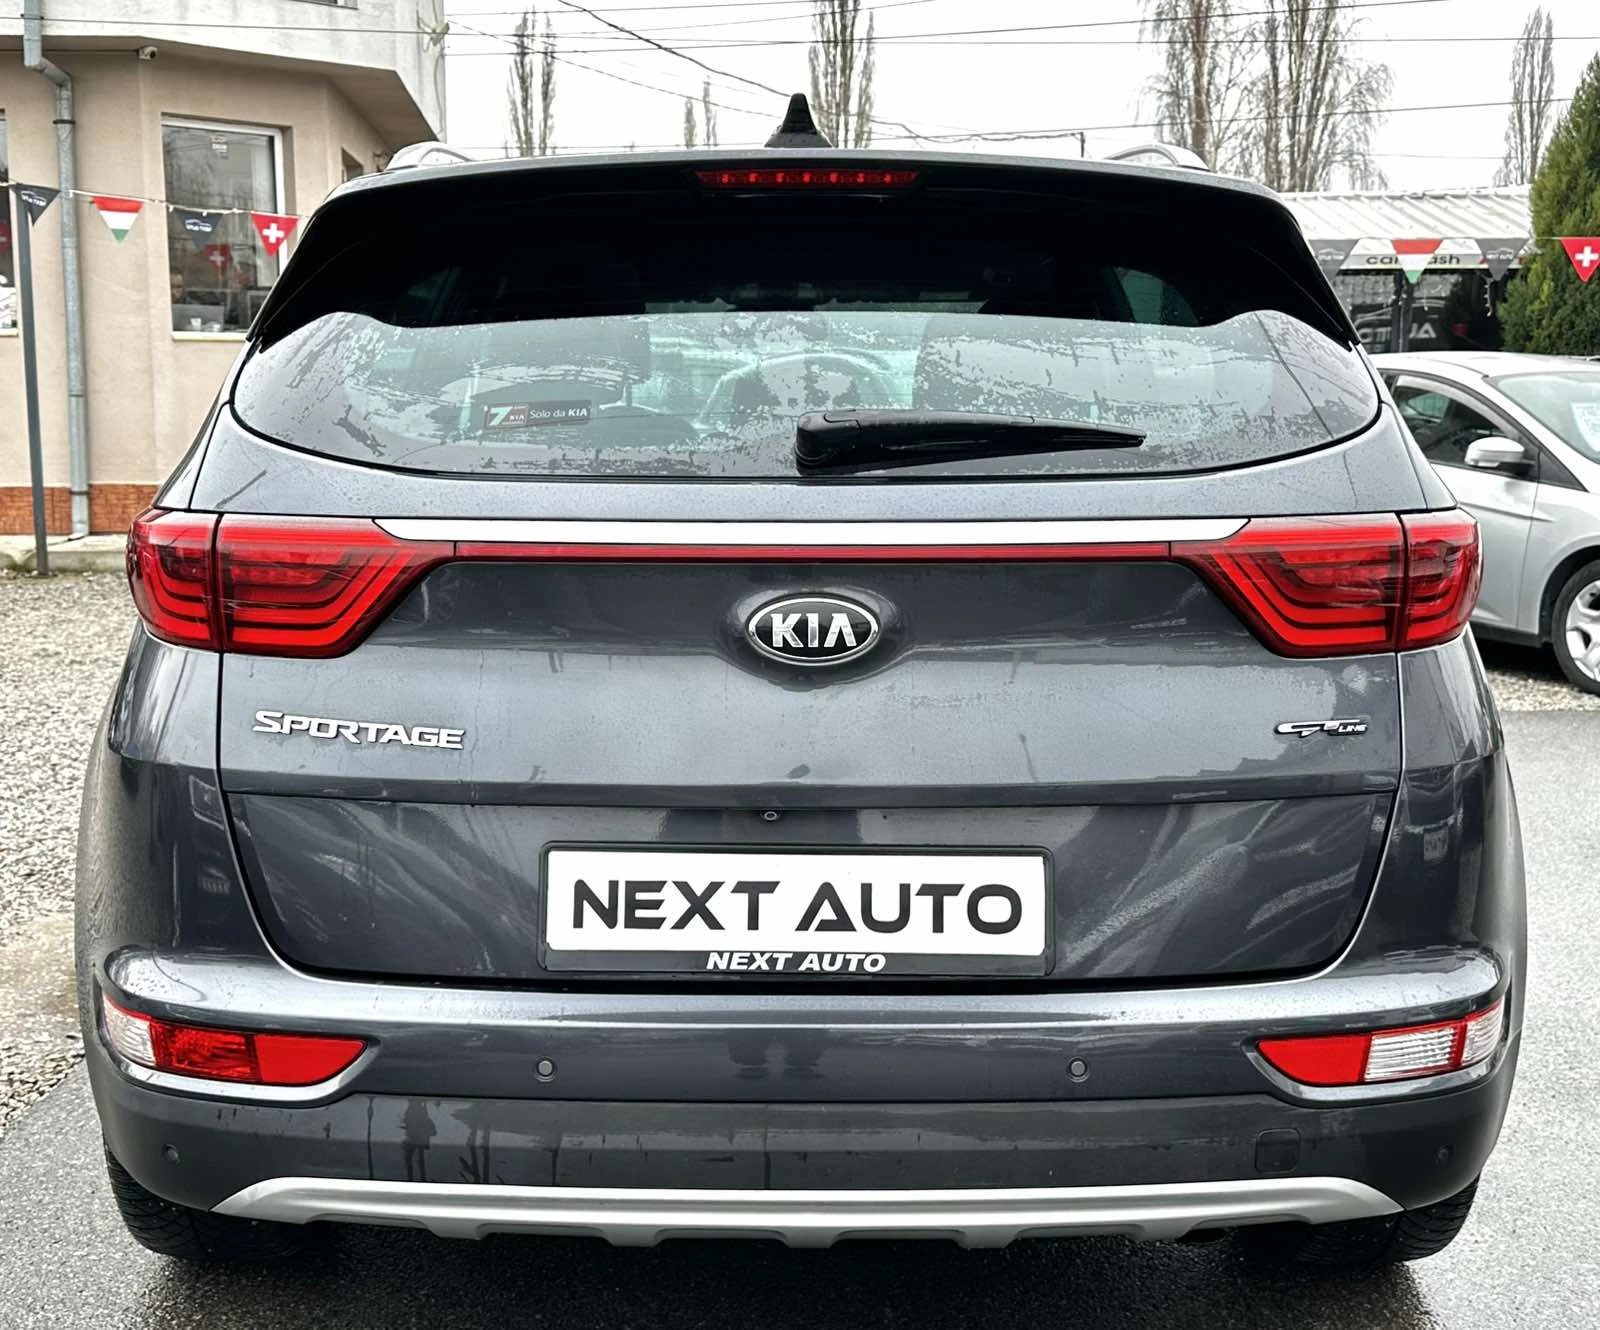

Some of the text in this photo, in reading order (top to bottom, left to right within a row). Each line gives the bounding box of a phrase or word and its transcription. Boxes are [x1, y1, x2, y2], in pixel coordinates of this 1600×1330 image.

[488, 406, 513, 426] 7
[530, 409, 551, 418] Solo
[553, 408, 565, 417] da
[568, 408, 588, 417] KIA
[770, 613, 857, 647] KIA
[252, 710, 465, 749] SPORTAGE
[572, 878, 1023, 935] NEXT AUTO
[706, 950, 887, 973] NEXT AUTO
